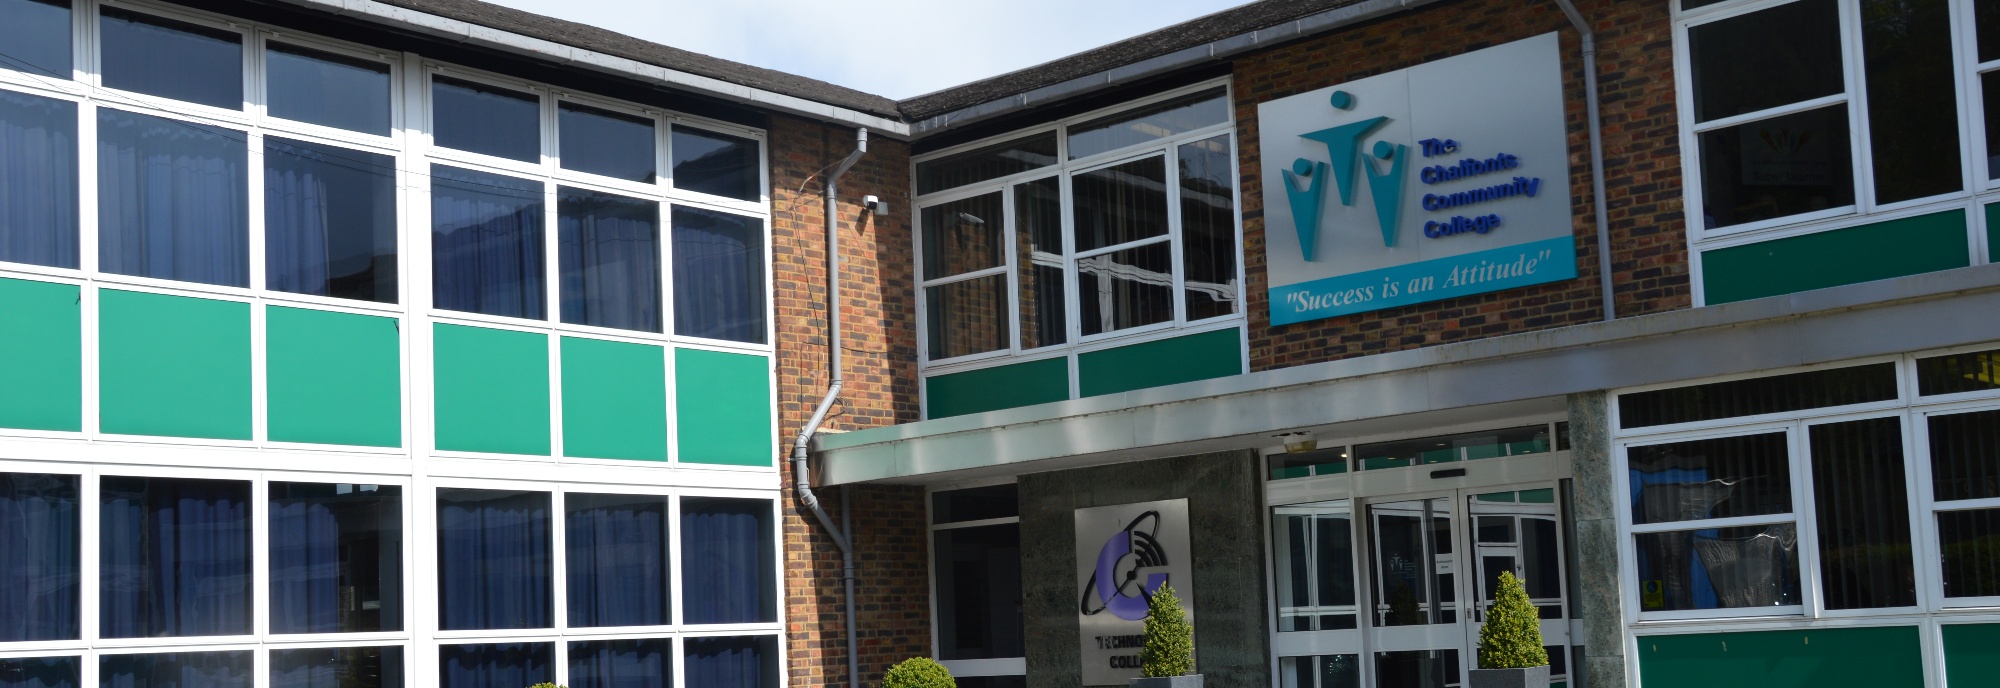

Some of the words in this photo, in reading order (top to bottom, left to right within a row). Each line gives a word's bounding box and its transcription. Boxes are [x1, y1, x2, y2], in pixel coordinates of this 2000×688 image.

[1418, 138, 1457, 157] The
[1420, 152, 1518, 184] Chalfonts
[1422, 176, 1540, 211] Community
[1423, 211, 1500, 239] College
[1287, 284, 1374, 313] "Success
[1382, 276, 1400, 298] is
[1407, 274, 1435, 294] an
[1443, 249, 1552, 288] Attitude"
[1095, 634, 1148, 649] TECHNO
[1109, 654, 1144, 669] COLL
